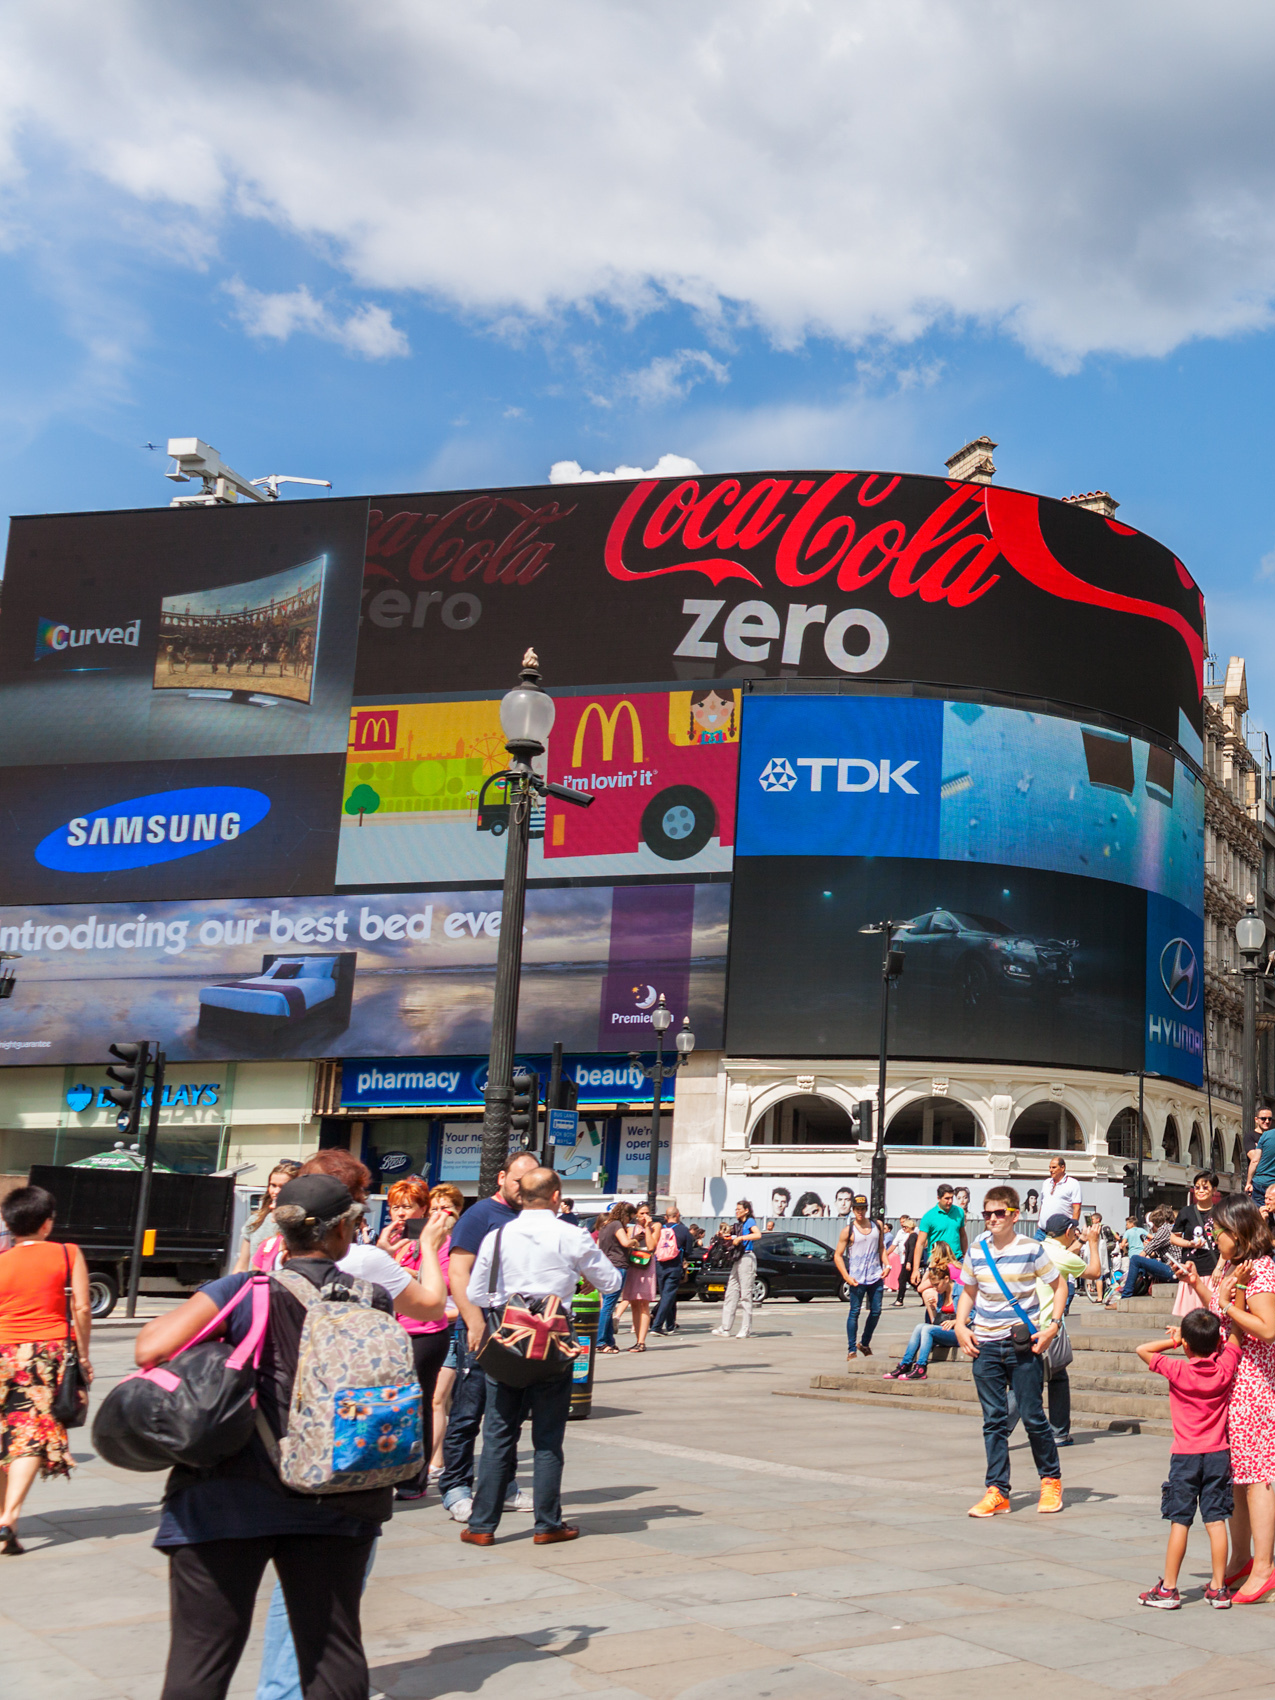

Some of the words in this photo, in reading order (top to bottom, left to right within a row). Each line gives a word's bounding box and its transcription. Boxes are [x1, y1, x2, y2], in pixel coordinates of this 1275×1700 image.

[358, 588, 482, 631] ero
[52, 618, 141, 650] Curved
[673, 599, 889, 674] zero
[797, 758, 920, 795] TDK
[67, 812, 241, 847] SAMSUNG
[0, 913, 190, 954] ntroducing
[199, 918, 261, 946] our
[269, 909, 349, 944] best
[359, 905, 433, 941] bed
[1149, 1014, 1203, 1058] HYUNDAI
[358, 1066, 460, 1093] pharmacy
[575, 1065, 645, 1090] beauty
[444, 1145, 453, 1154] is
[445, 1133, 469, 1142] Your
